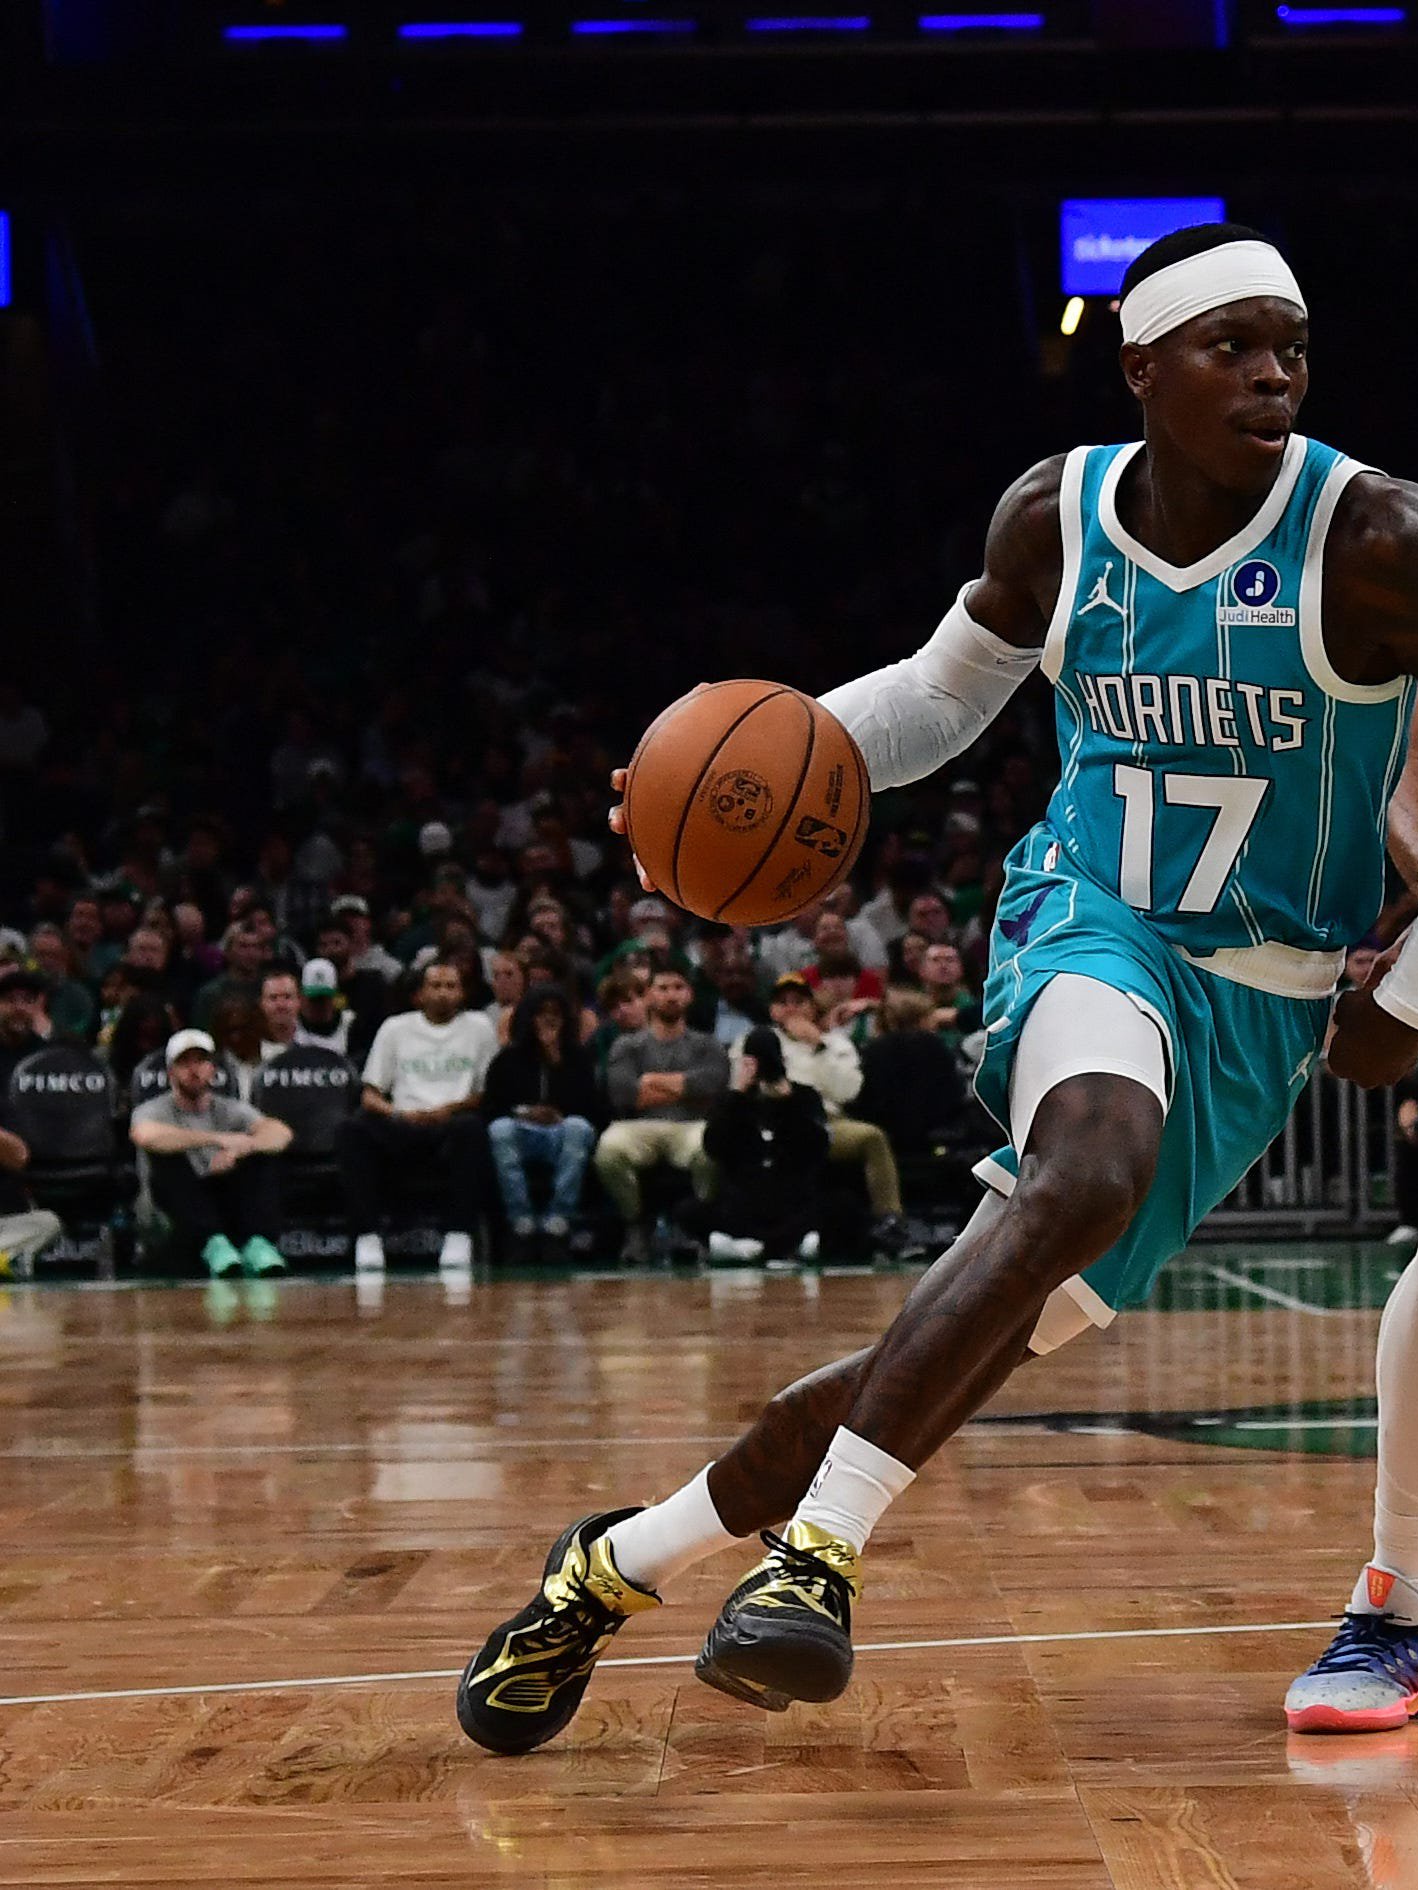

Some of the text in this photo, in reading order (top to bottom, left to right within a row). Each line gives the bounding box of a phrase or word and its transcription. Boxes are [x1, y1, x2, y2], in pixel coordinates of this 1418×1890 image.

[1220, 610, 1294, 624] Judi Health
[1074, 671, 1312, 752] HORNETS
[1112, 762, 1273, 914] 17
[17, 1071, 106, 1094] PIMCO
[139, 1068, 228, 1088] PIO
[262, 1067, 350, 1088] PIMCO
